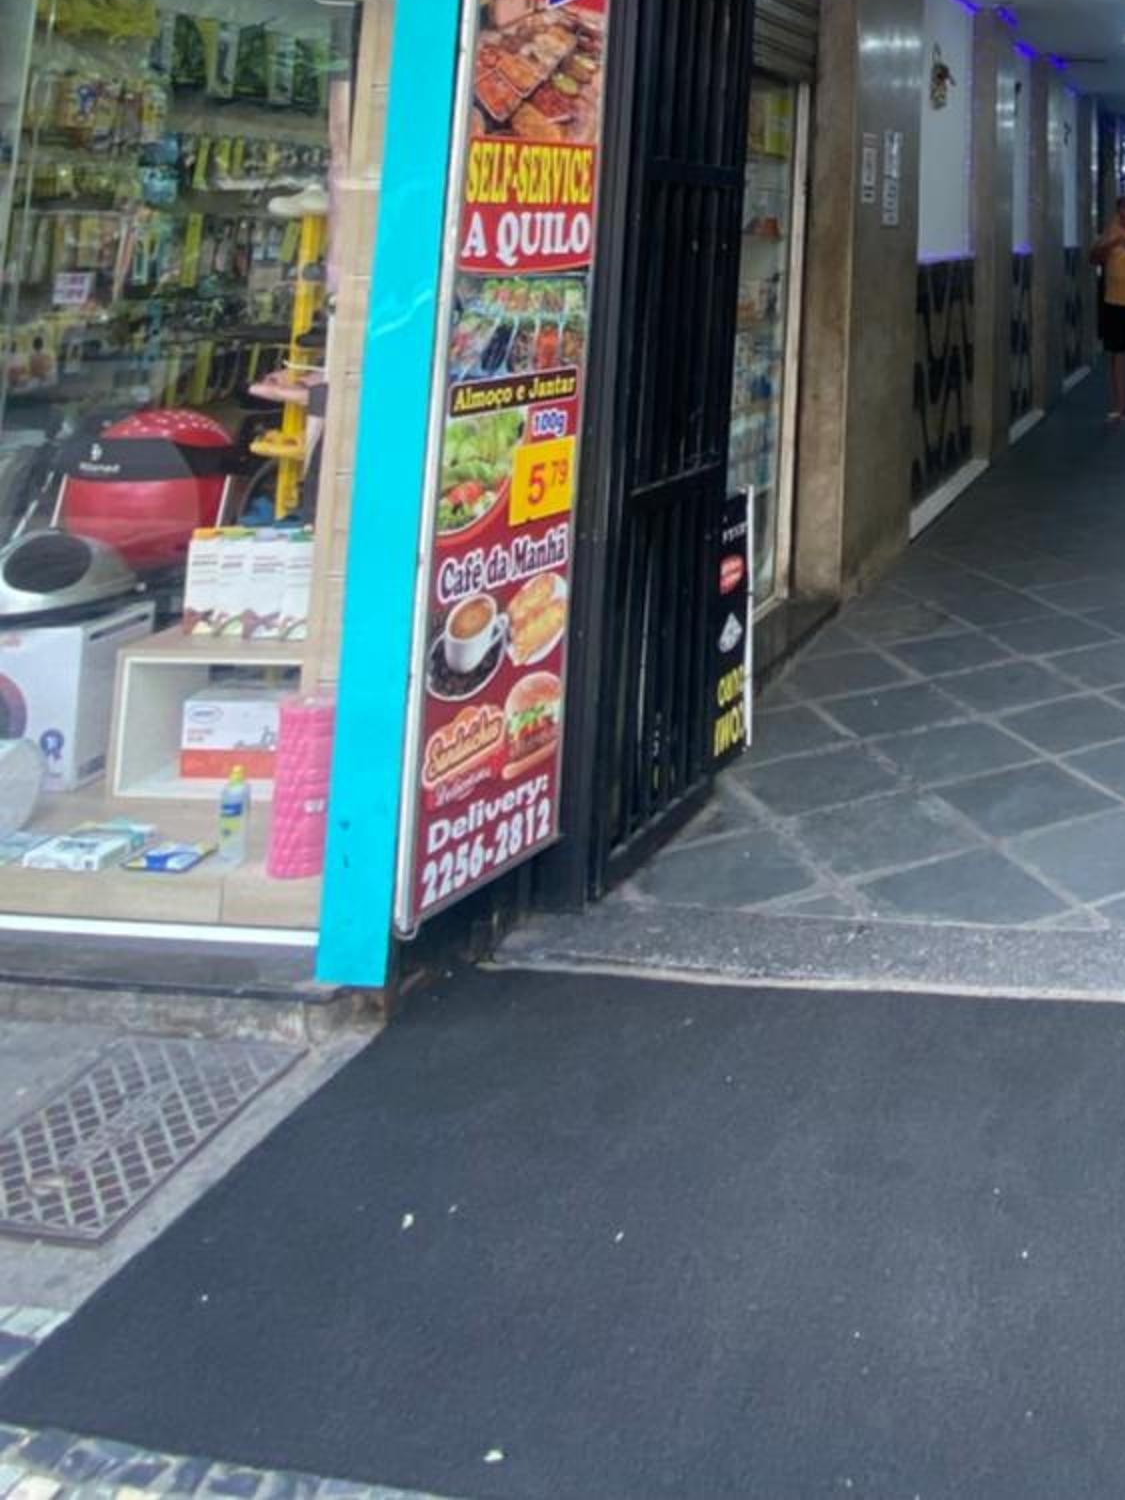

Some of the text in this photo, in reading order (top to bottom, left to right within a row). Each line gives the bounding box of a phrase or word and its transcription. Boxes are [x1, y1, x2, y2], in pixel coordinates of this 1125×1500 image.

[466, 140, 593, 204] SELF-SERVICE
[461, 211, 591, 267] A QUILO
[516, 385, 525, 400] e
[528, 375, 577, 399] Jantar
[533, 409, 567, 436] 100g
[439, 526, 569, 602] Café da Manhã
[428, 774, 549, 855] Delivery:
[420, 798, 550, 909] 2256-2812
